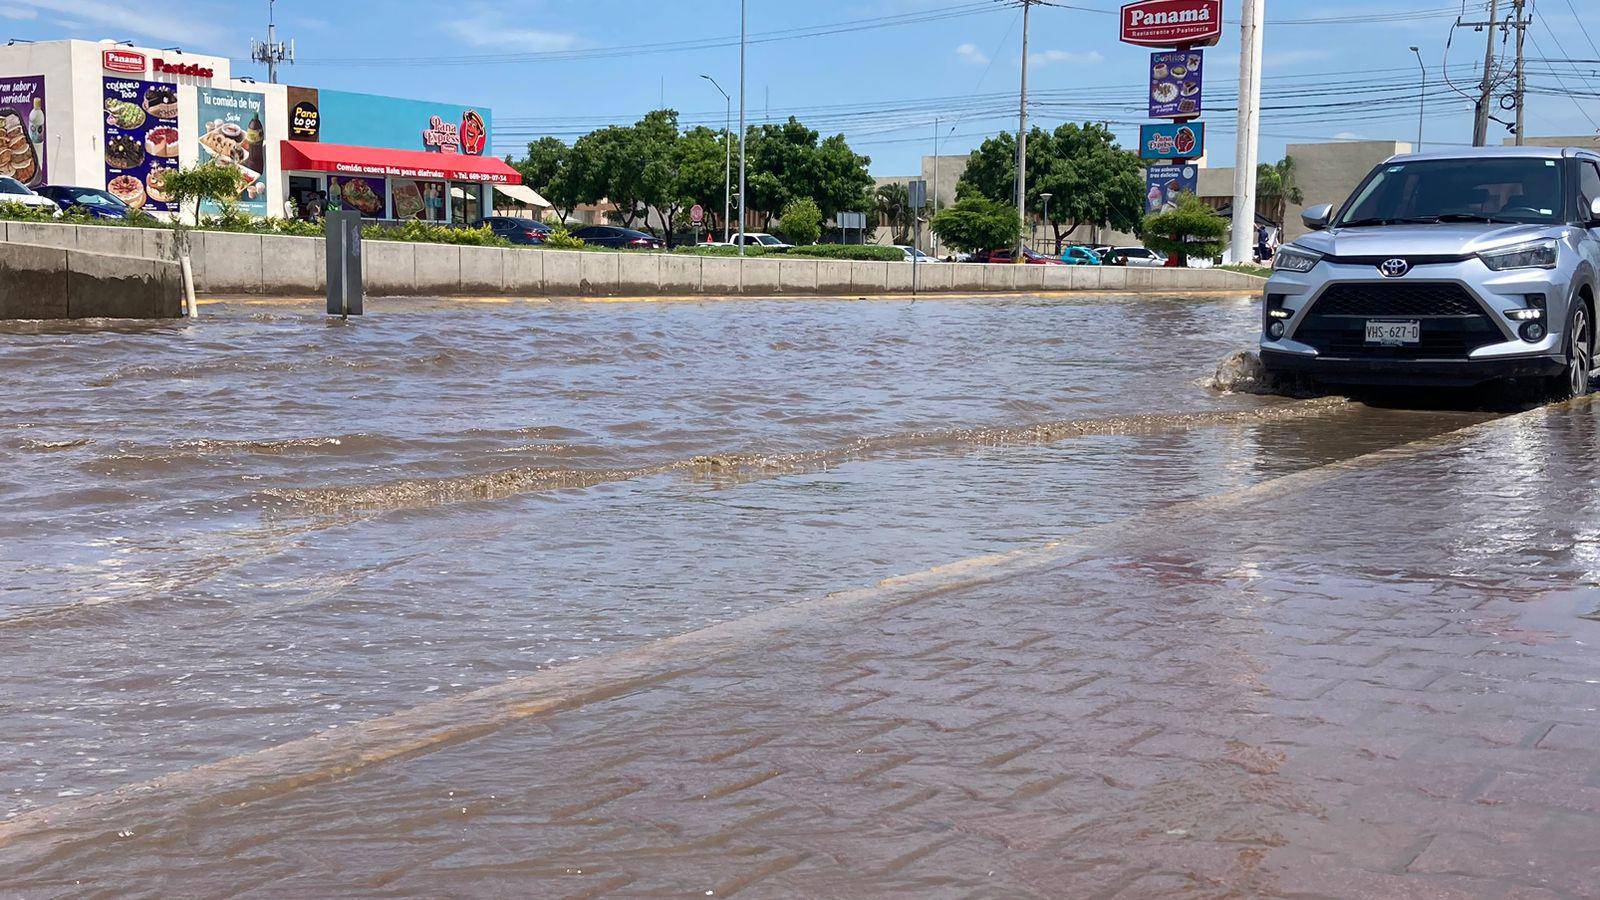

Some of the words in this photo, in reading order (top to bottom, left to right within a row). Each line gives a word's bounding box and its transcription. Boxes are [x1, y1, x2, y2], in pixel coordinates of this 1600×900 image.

[1131, 4, 1210, 26] Panamá
[107, 52, 143, 65] Panamá
[152, 58, 214, 78] Pasteles
[12, 80, 31, 92] sabor
[31, 83, 38, 94] y
[1, 92, 31, 104] variedad
[203, 92, 211, 105] Tu
[212, 95, 238, 108] comida
[239, 97, 247, 108] de
[248, 98, 261, 112] hoy
[295, 107, 317, 119] Pana
[294, 117, 304, 126] to
[305, 118, 316, 128] go
[430, 115, 457, 134] Pana
[424, 129, 461, 146] Express
[336, 163, 362, 172] Comida
[363, 166, 385, 174] casera
[386, 166, 400, 175] lista
[401, 169, 416, 177] para
[417, 169, 444, 178] disfrutar
[458, 172, 468, 180] Tel.
